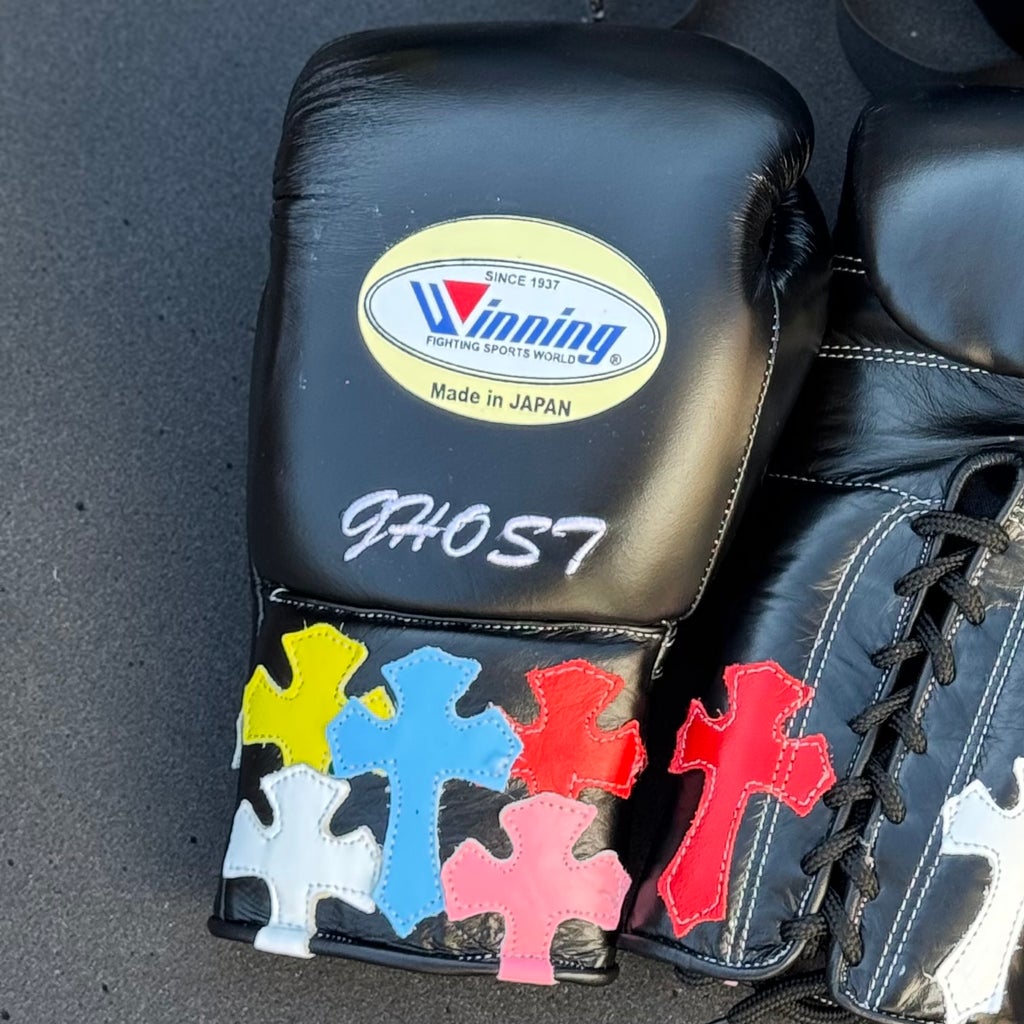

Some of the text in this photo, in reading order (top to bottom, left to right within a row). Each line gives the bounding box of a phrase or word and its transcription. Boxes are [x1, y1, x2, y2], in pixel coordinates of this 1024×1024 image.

[485, 270, 560, 291] SINCE 1937
[410, 279, 627, 365] Winning
[426, 336, 576, 365] FIGHTING SPORTS WORLD
[431, 382, 572, 417] Made in JAPAN
